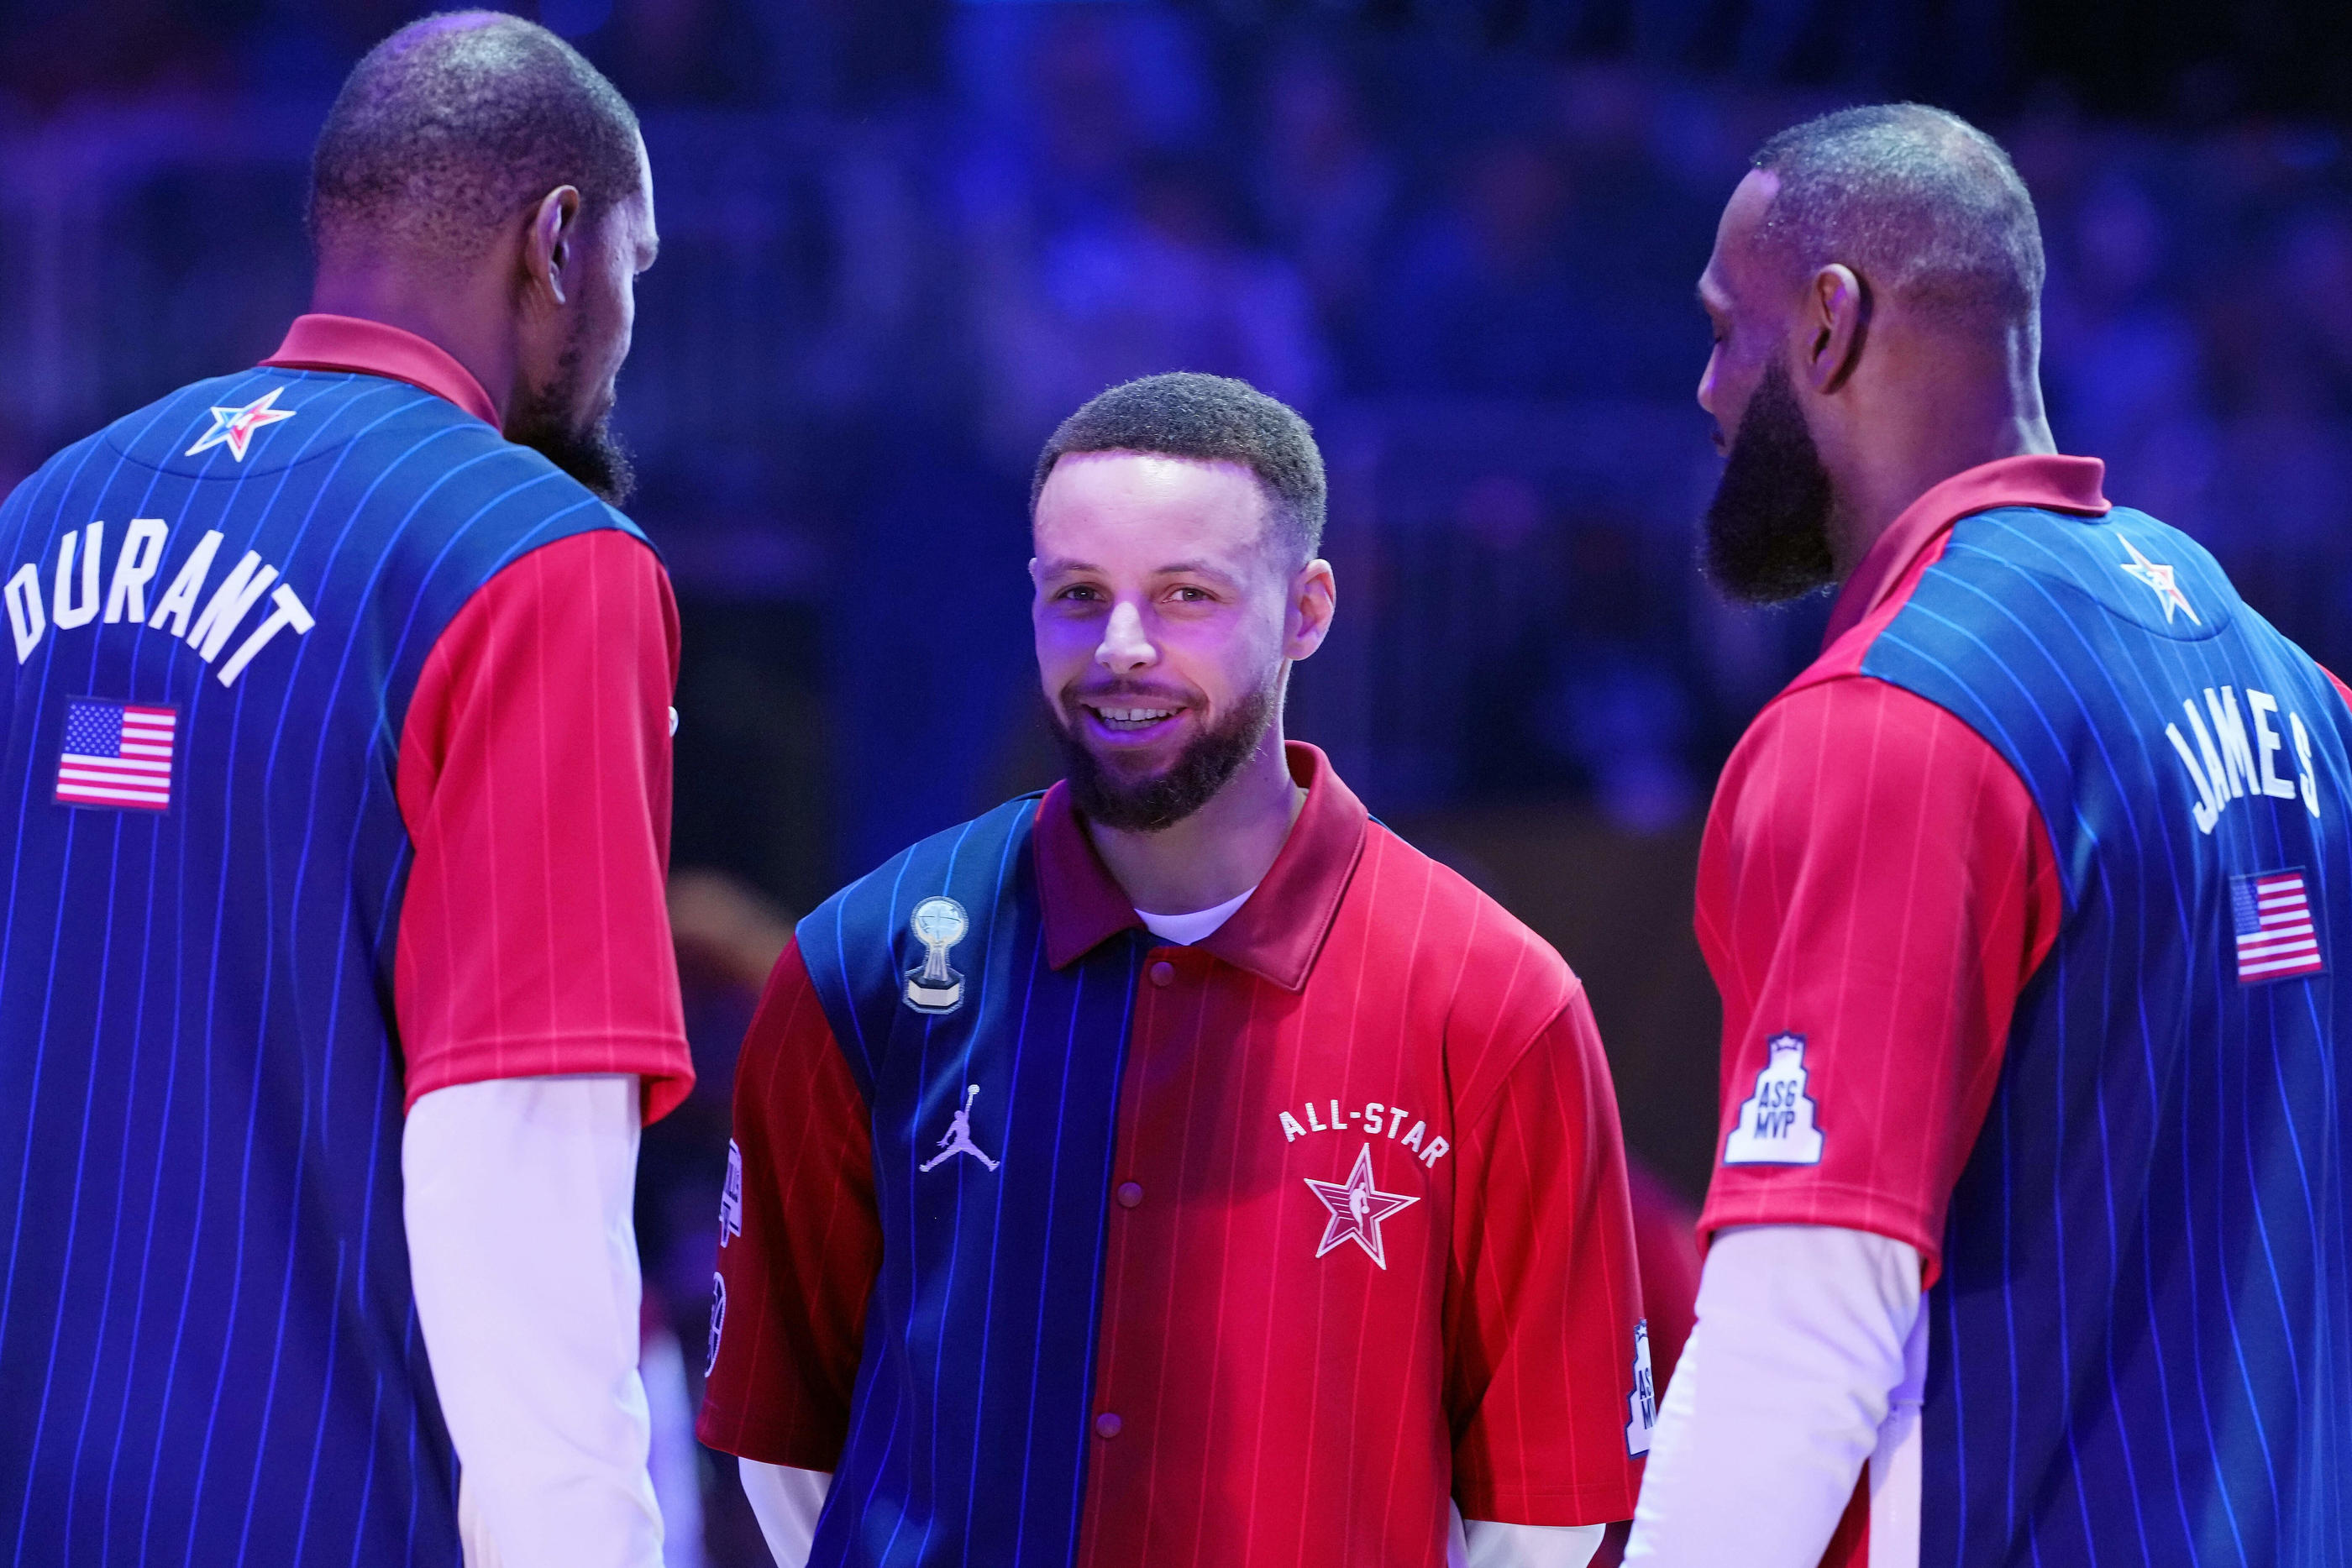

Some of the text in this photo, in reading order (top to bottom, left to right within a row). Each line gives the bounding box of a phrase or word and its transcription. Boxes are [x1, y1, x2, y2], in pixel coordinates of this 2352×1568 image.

[4, 518, 315, 688] DURANT
[2165, 685, 2320, 834] JAMES
[1759, 1080, 1798, 1108] ASG
[1278, 1099, 1449, 1168] ALL-STAR
[1754, 1111, 1795, 1139] MVP
[1639, 1367, 1653, 1400] AS
